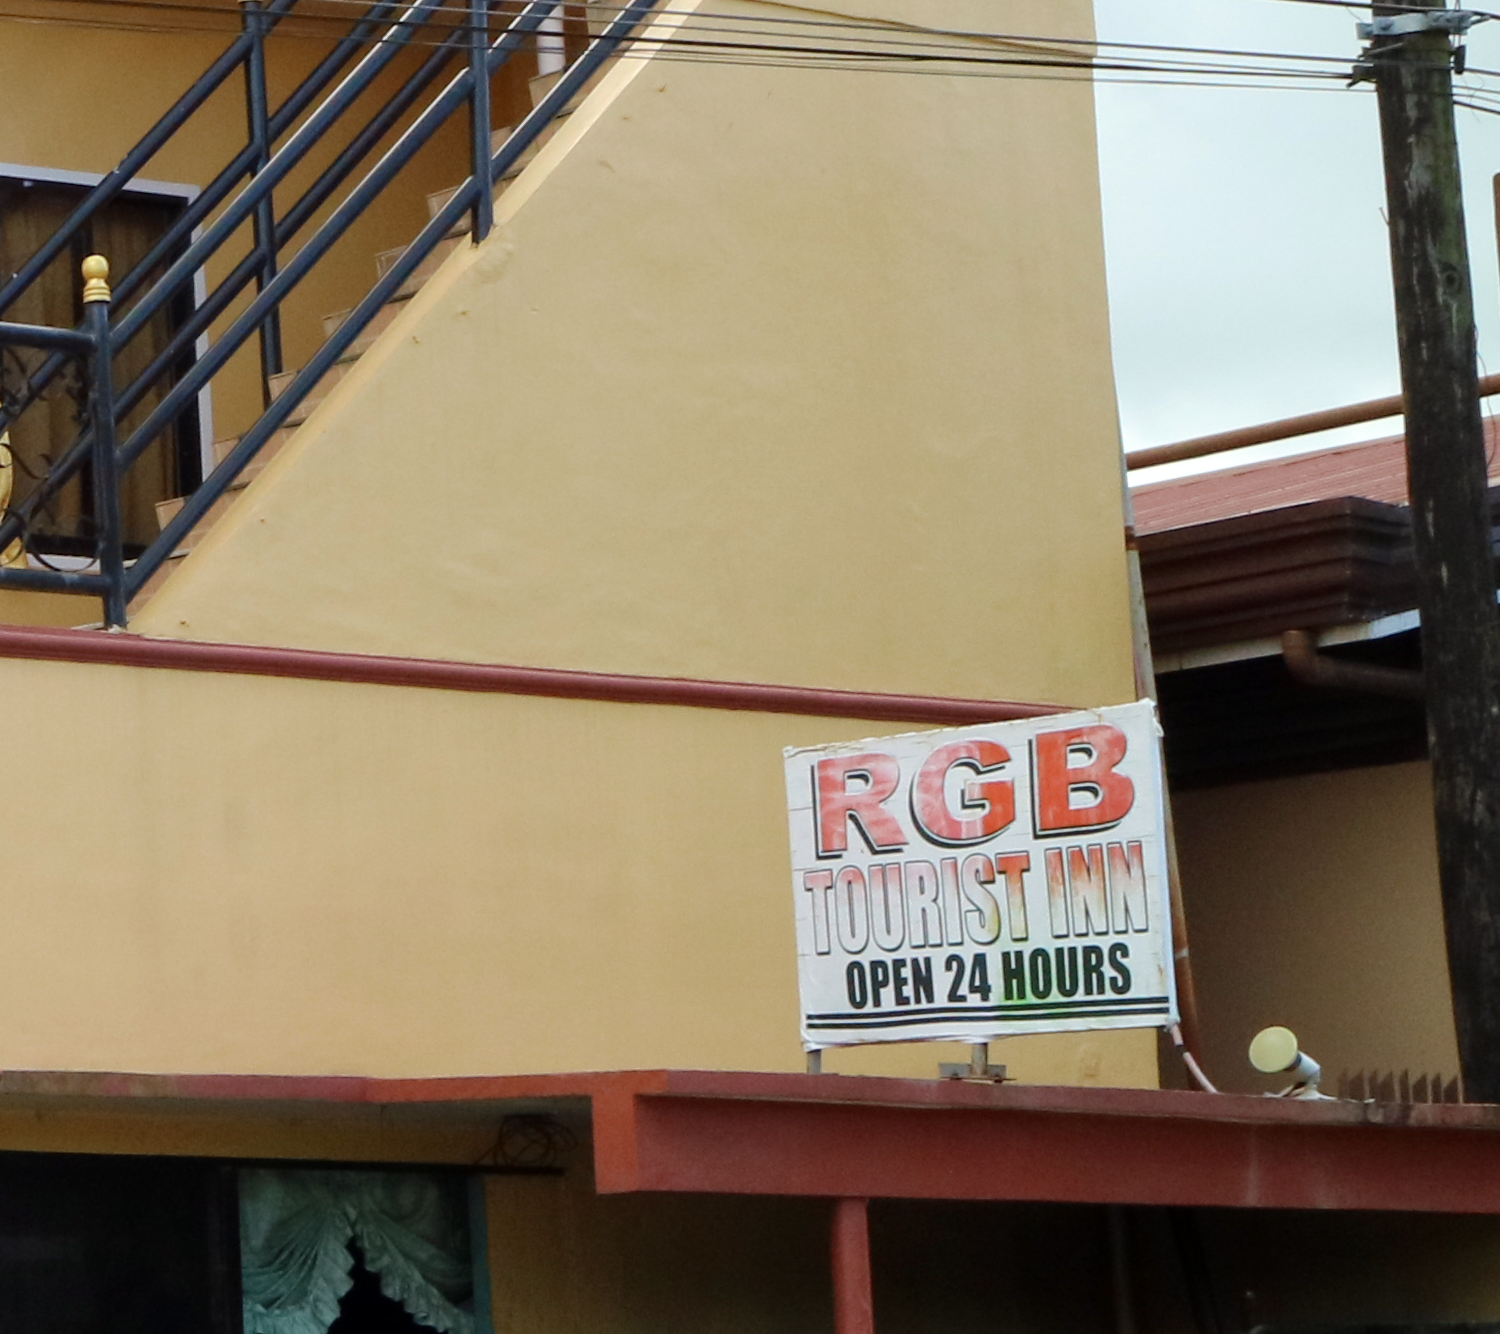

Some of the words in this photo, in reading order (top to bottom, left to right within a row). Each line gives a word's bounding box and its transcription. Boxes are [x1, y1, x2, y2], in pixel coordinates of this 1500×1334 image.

[810, 723, 1135, 861] RGB
[803, 850, 1031, 957] TOURIST
[1044, 840, 1150, 939] INN
[846, 956, 936, 1010] OPEN
[944, 952, 992, 1004] 24
[1002, 942, 1132, 1002] HOURS
